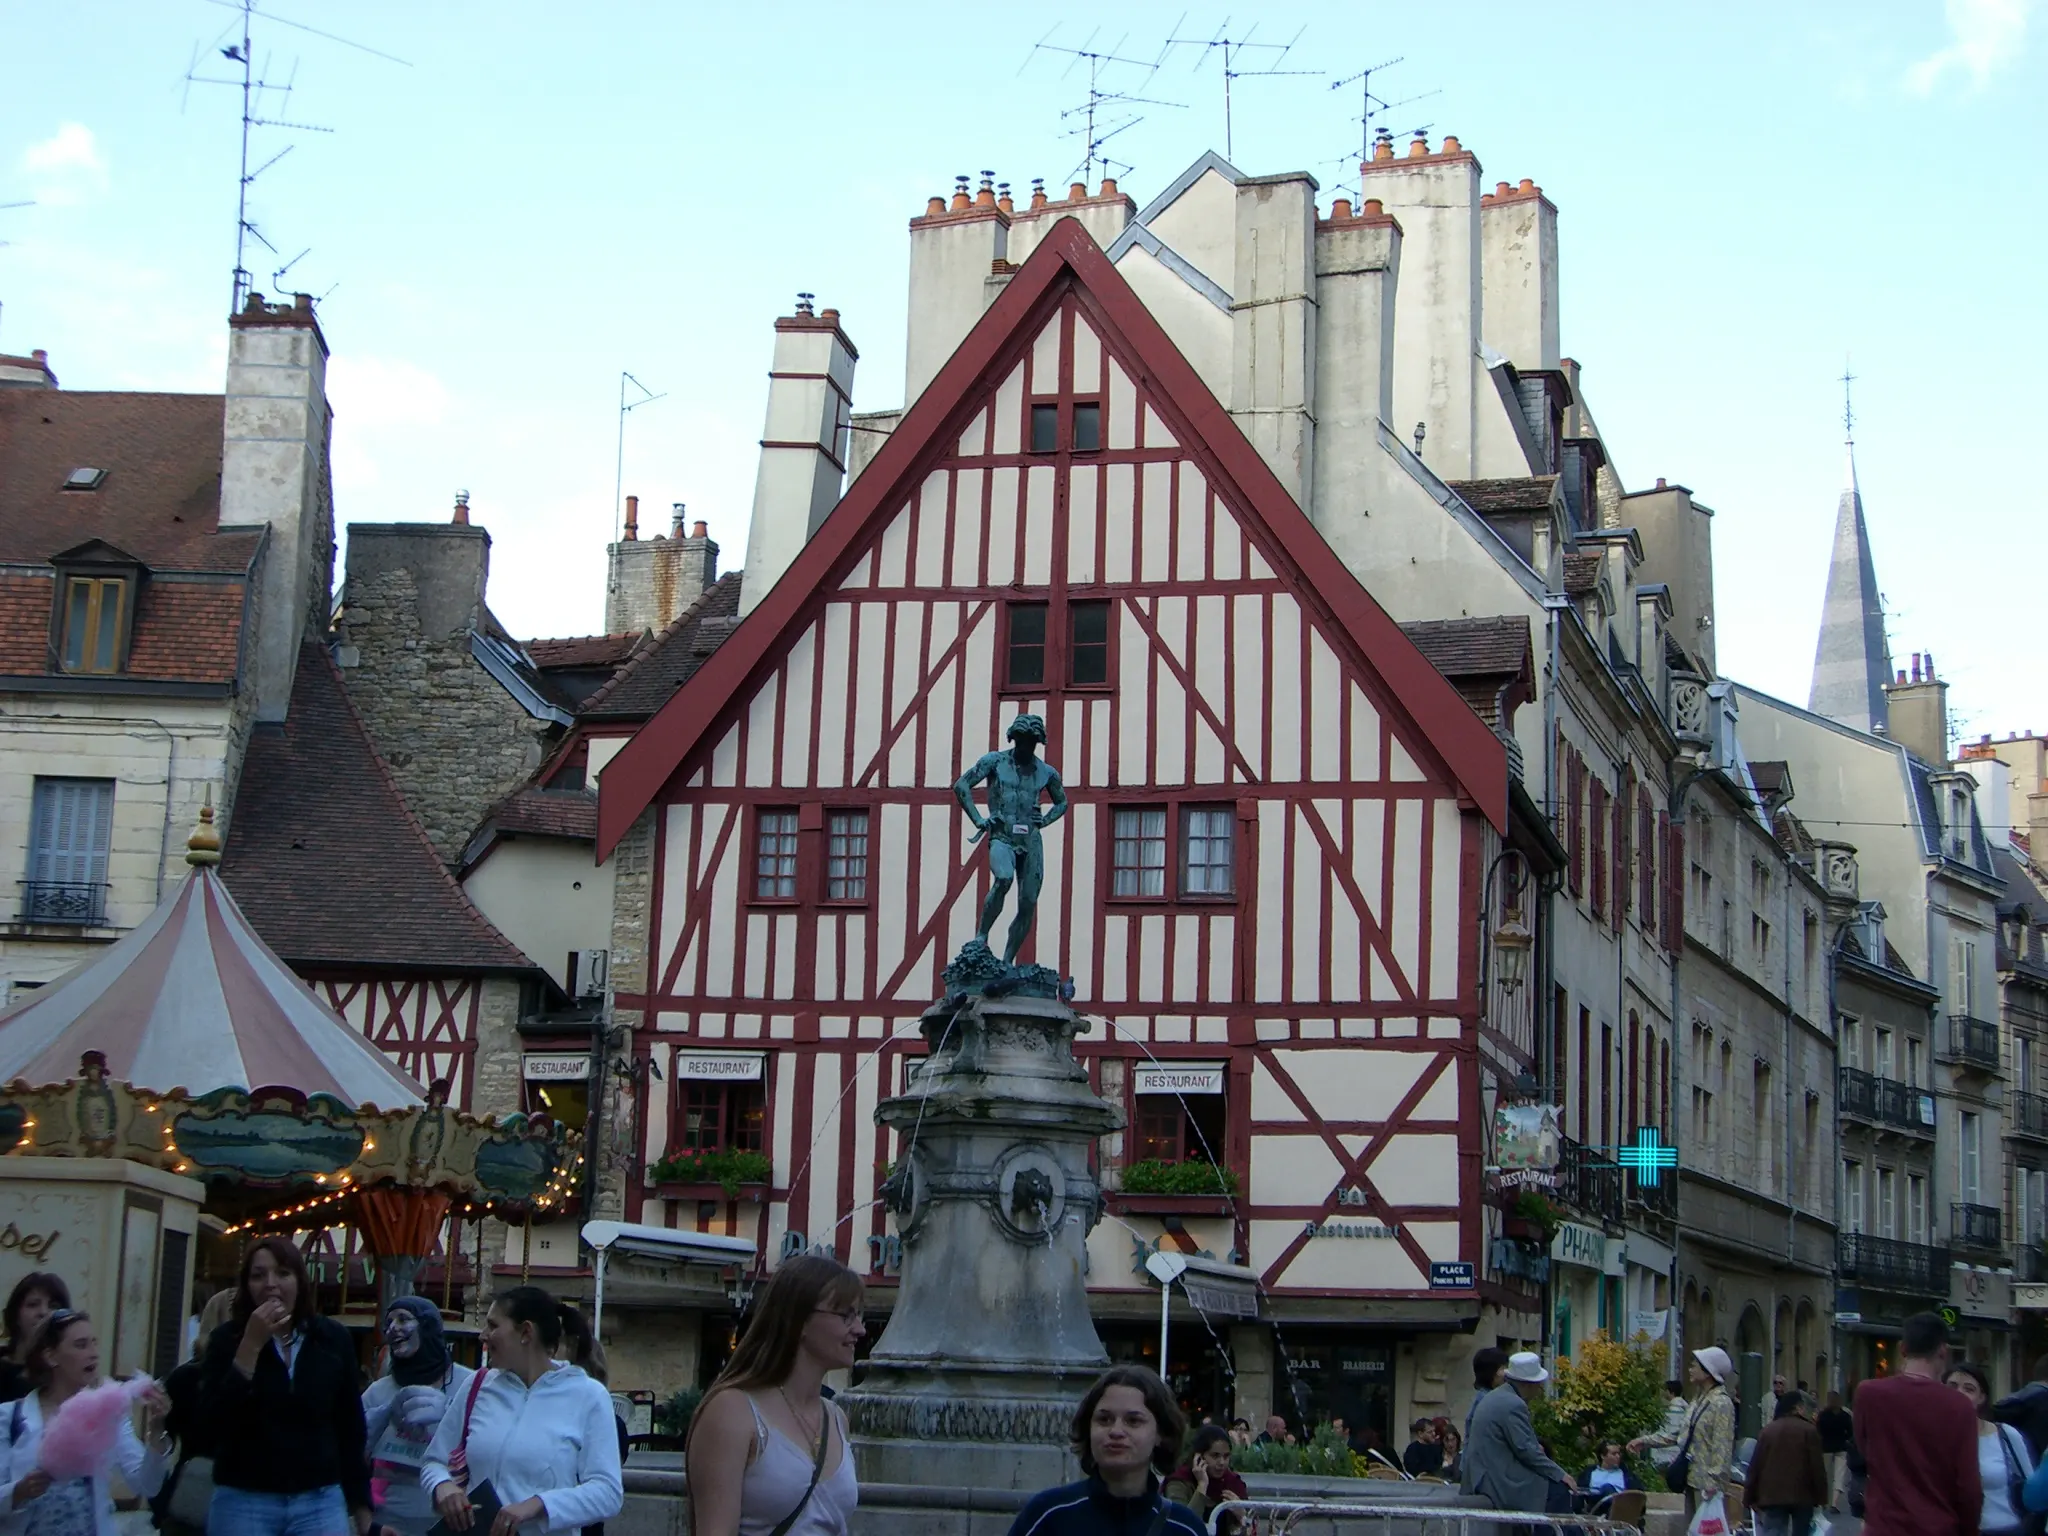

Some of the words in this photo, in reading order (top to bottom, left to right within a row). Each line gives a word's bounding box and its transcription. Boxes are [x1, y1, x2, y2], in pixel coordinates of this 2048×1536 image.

[530, 1062, 584, 1074] RESTAURANT
[688, 1061, 750, 1074] RESTAURANT
[1144, 1075, 1211, 1088] RESTAURANT
[1500, 1170, 1556, 1187] RESTAURANT
[1440, 1266, 1465, 1275] PLACE
[1455, 1276, 1471, 1285] RUDE
[1288, 1360, 1321, 1369] BAR
[1341, 1361, 1385, 1371] BRASSERIE
